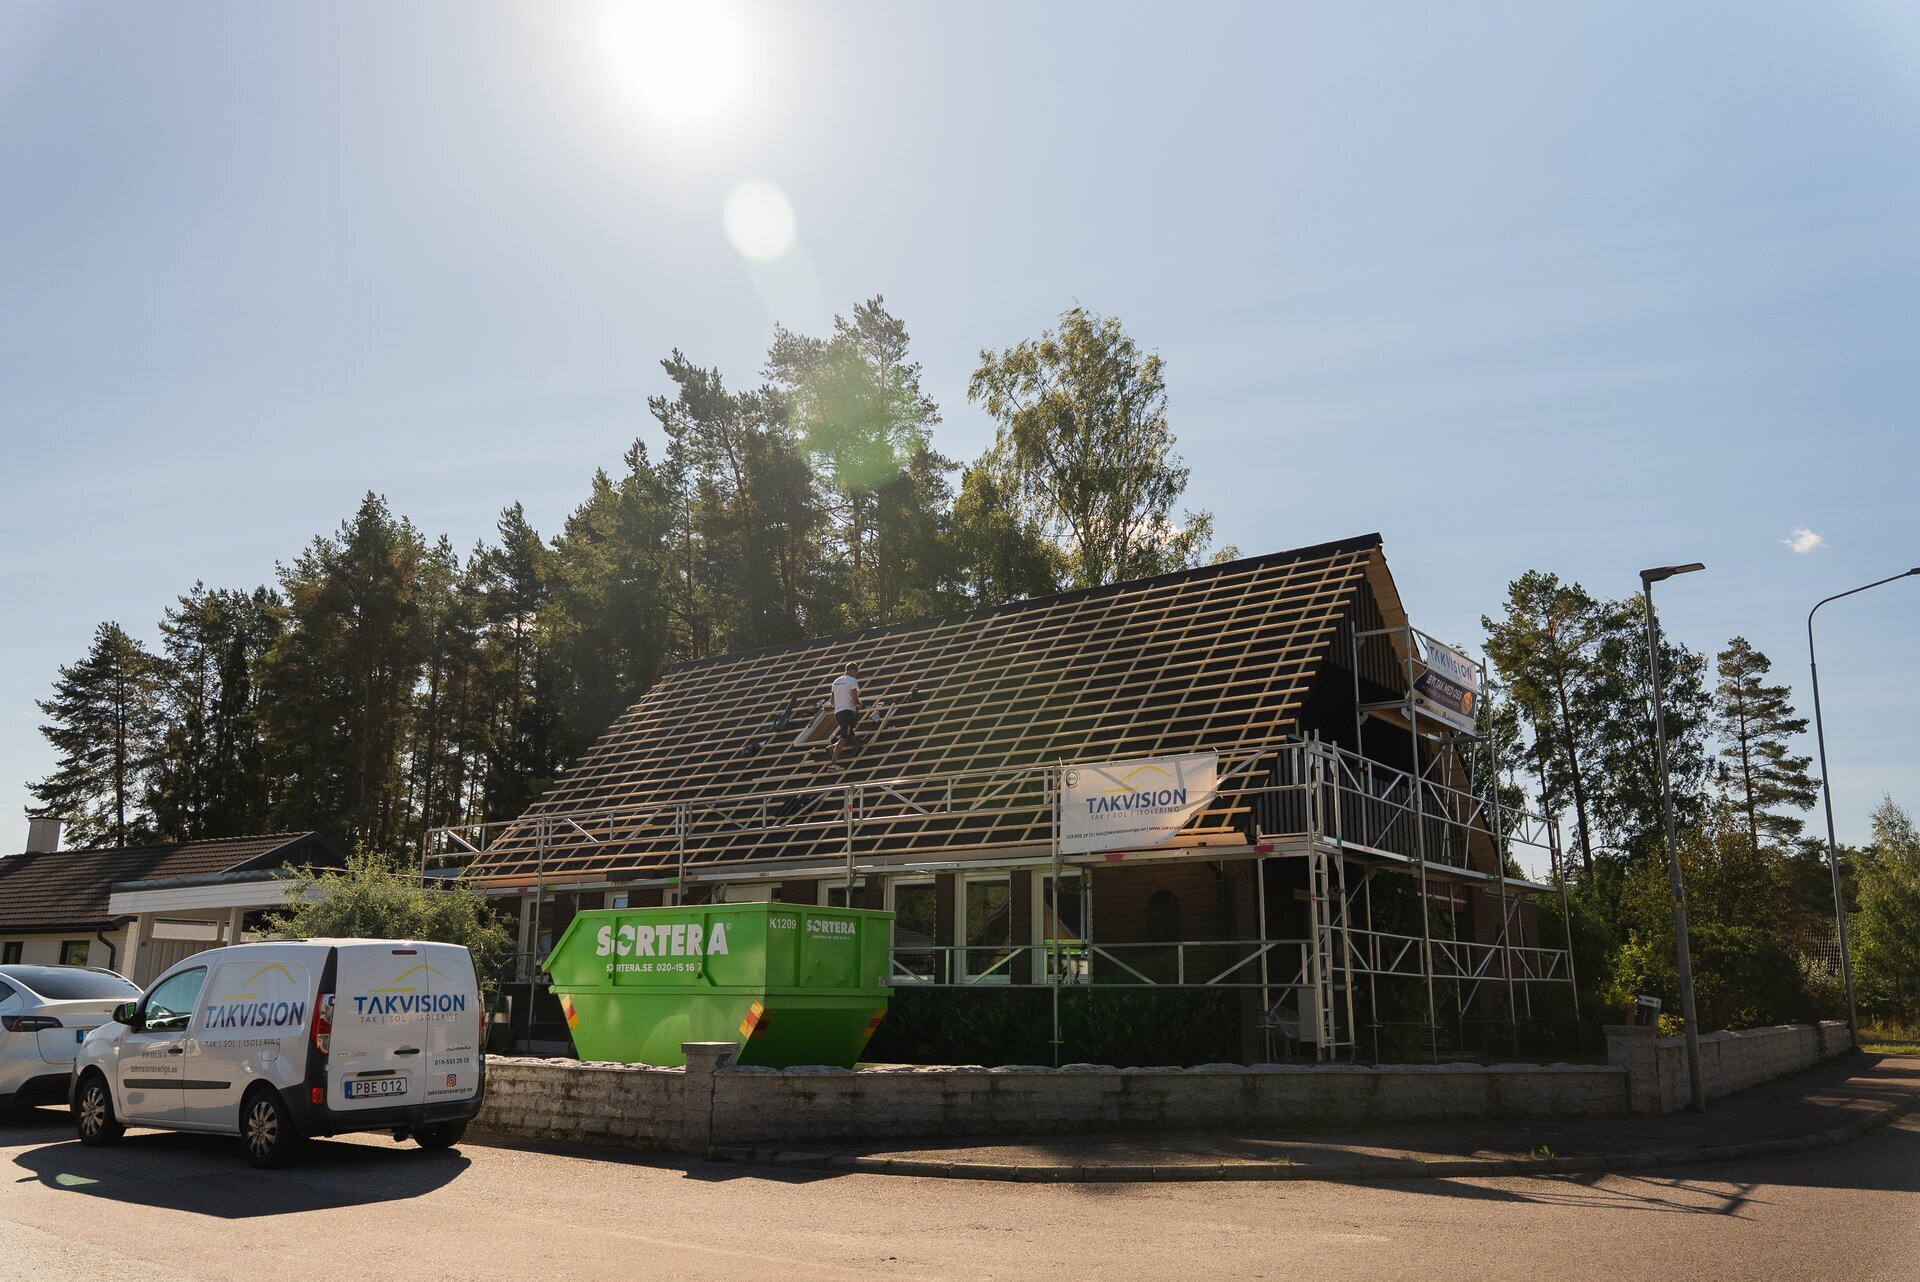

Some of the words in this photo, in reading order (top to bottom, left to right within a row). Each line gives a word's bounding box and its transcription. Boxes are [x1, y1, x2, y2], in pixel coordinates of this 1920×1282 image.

[1429, 646, 1473, 681] TAKVISION
[1086, 788, 1187, 813] TAKVISION
[1136, 806, 1180, 816] ISOLERING
[769, 917, 797, 929] K1209
[806, 919, 856, 934] SORTERA
[595, 922, 729, 957] SORTERA
[606, 963, 653, 973] SORTERA.SE
[656, 962, 684, 972] 020-15
[685, 962, 695, 972] 16
[353, 994, 465, 1015] TAKVISION
[205, 1001, 305, 1028] TAKVISION
[416, 1013, 459, 1021] ISOLERING
[205, 1040, 217, 1048] TAK
[223, 1040, 236, 1048] SOL
[243, 1037, 281, 1047] ISOLERING
[434, 1058, 456, 1066] 019-555
[356, 1081, 378, 1094] PBE
[381, 1080, 402, 1092] 012
[427, 1086, 473, 1096] takvisionsverige.se
